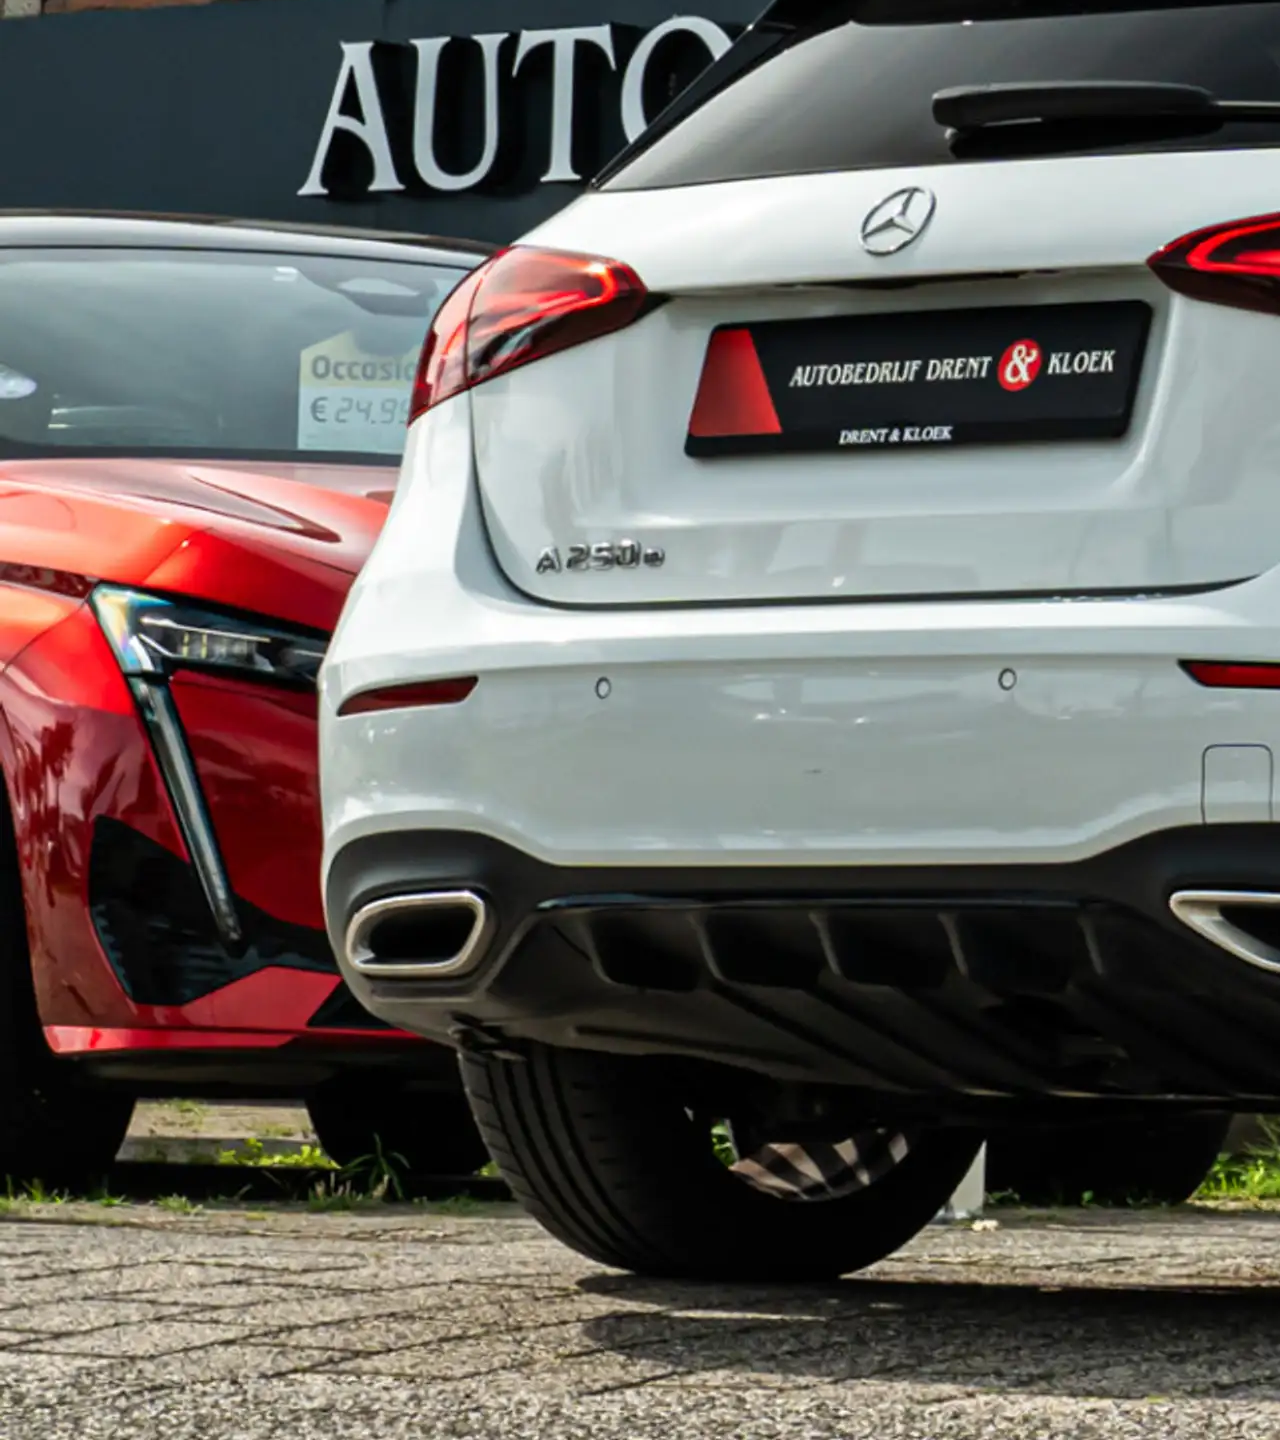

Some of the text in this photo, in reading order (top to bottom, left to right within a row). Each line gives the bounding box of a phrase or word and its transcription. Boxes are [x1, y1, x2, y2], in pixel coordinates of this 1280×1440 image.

[298, 17, 734, 195] AUTO
[788, 344, 1116, 388] AUTOBEDRIJF DRENT & KLOEK
[838, 428, 888, 445] DRENT
[902, 425, 953, 442] KLOEK
